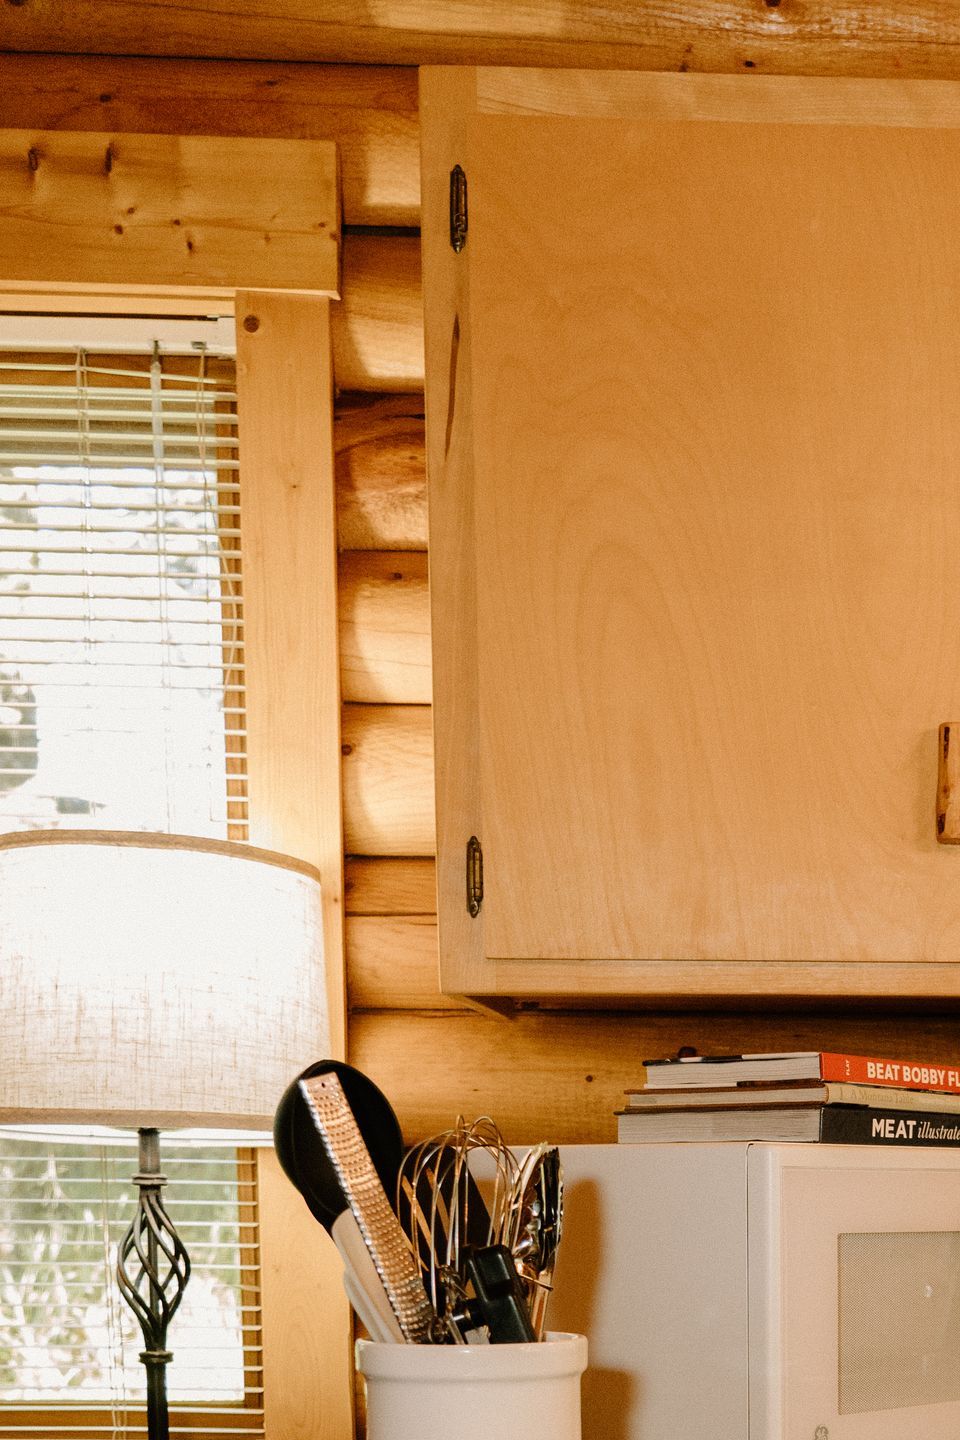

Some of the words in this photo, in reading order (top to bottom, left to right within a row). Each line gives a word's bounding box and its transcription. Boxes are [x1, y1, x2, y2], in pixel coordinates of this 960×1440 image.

[867, 1061, 900, 1081] BEAT
[902, 1065, 946, 1086] BOBBY
[871, 1118, 917, 1139] MEAT
